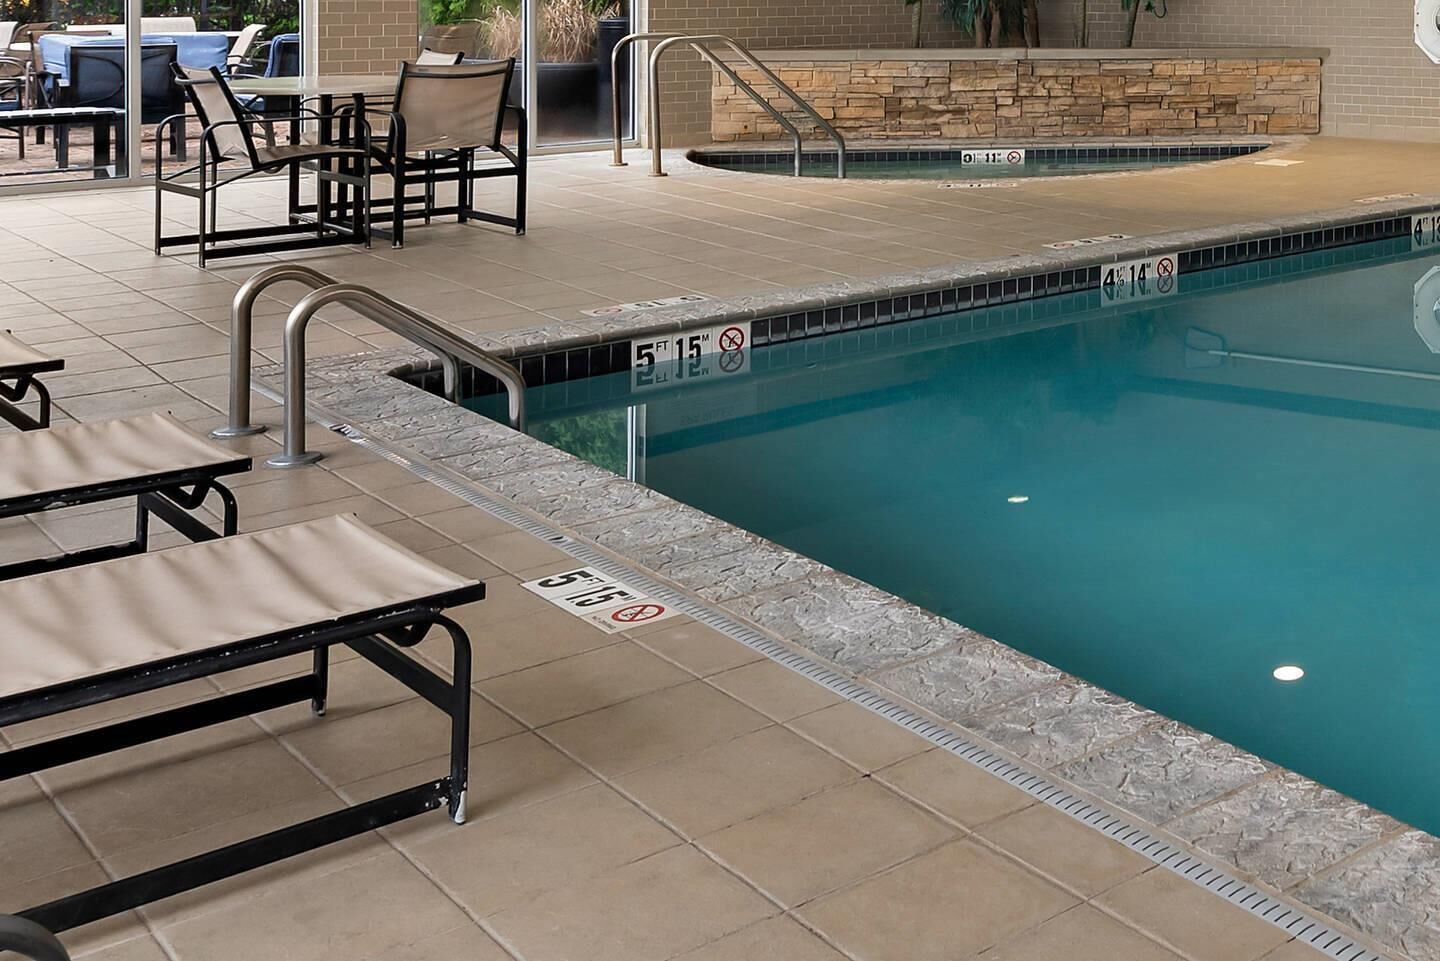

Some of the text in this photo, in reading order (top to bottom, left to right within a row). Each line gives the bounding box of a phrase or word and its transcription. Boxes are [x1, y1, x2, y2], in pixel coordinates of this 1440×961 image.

[1414, 218, 1422, 233] 4
[636, 343, 655, 368] 5
[657, 340, 670, 352] FT
[701, 333, 709, 342] M
[537, 570, 593, 588] 5
[581, 577, 605, 586] FT
